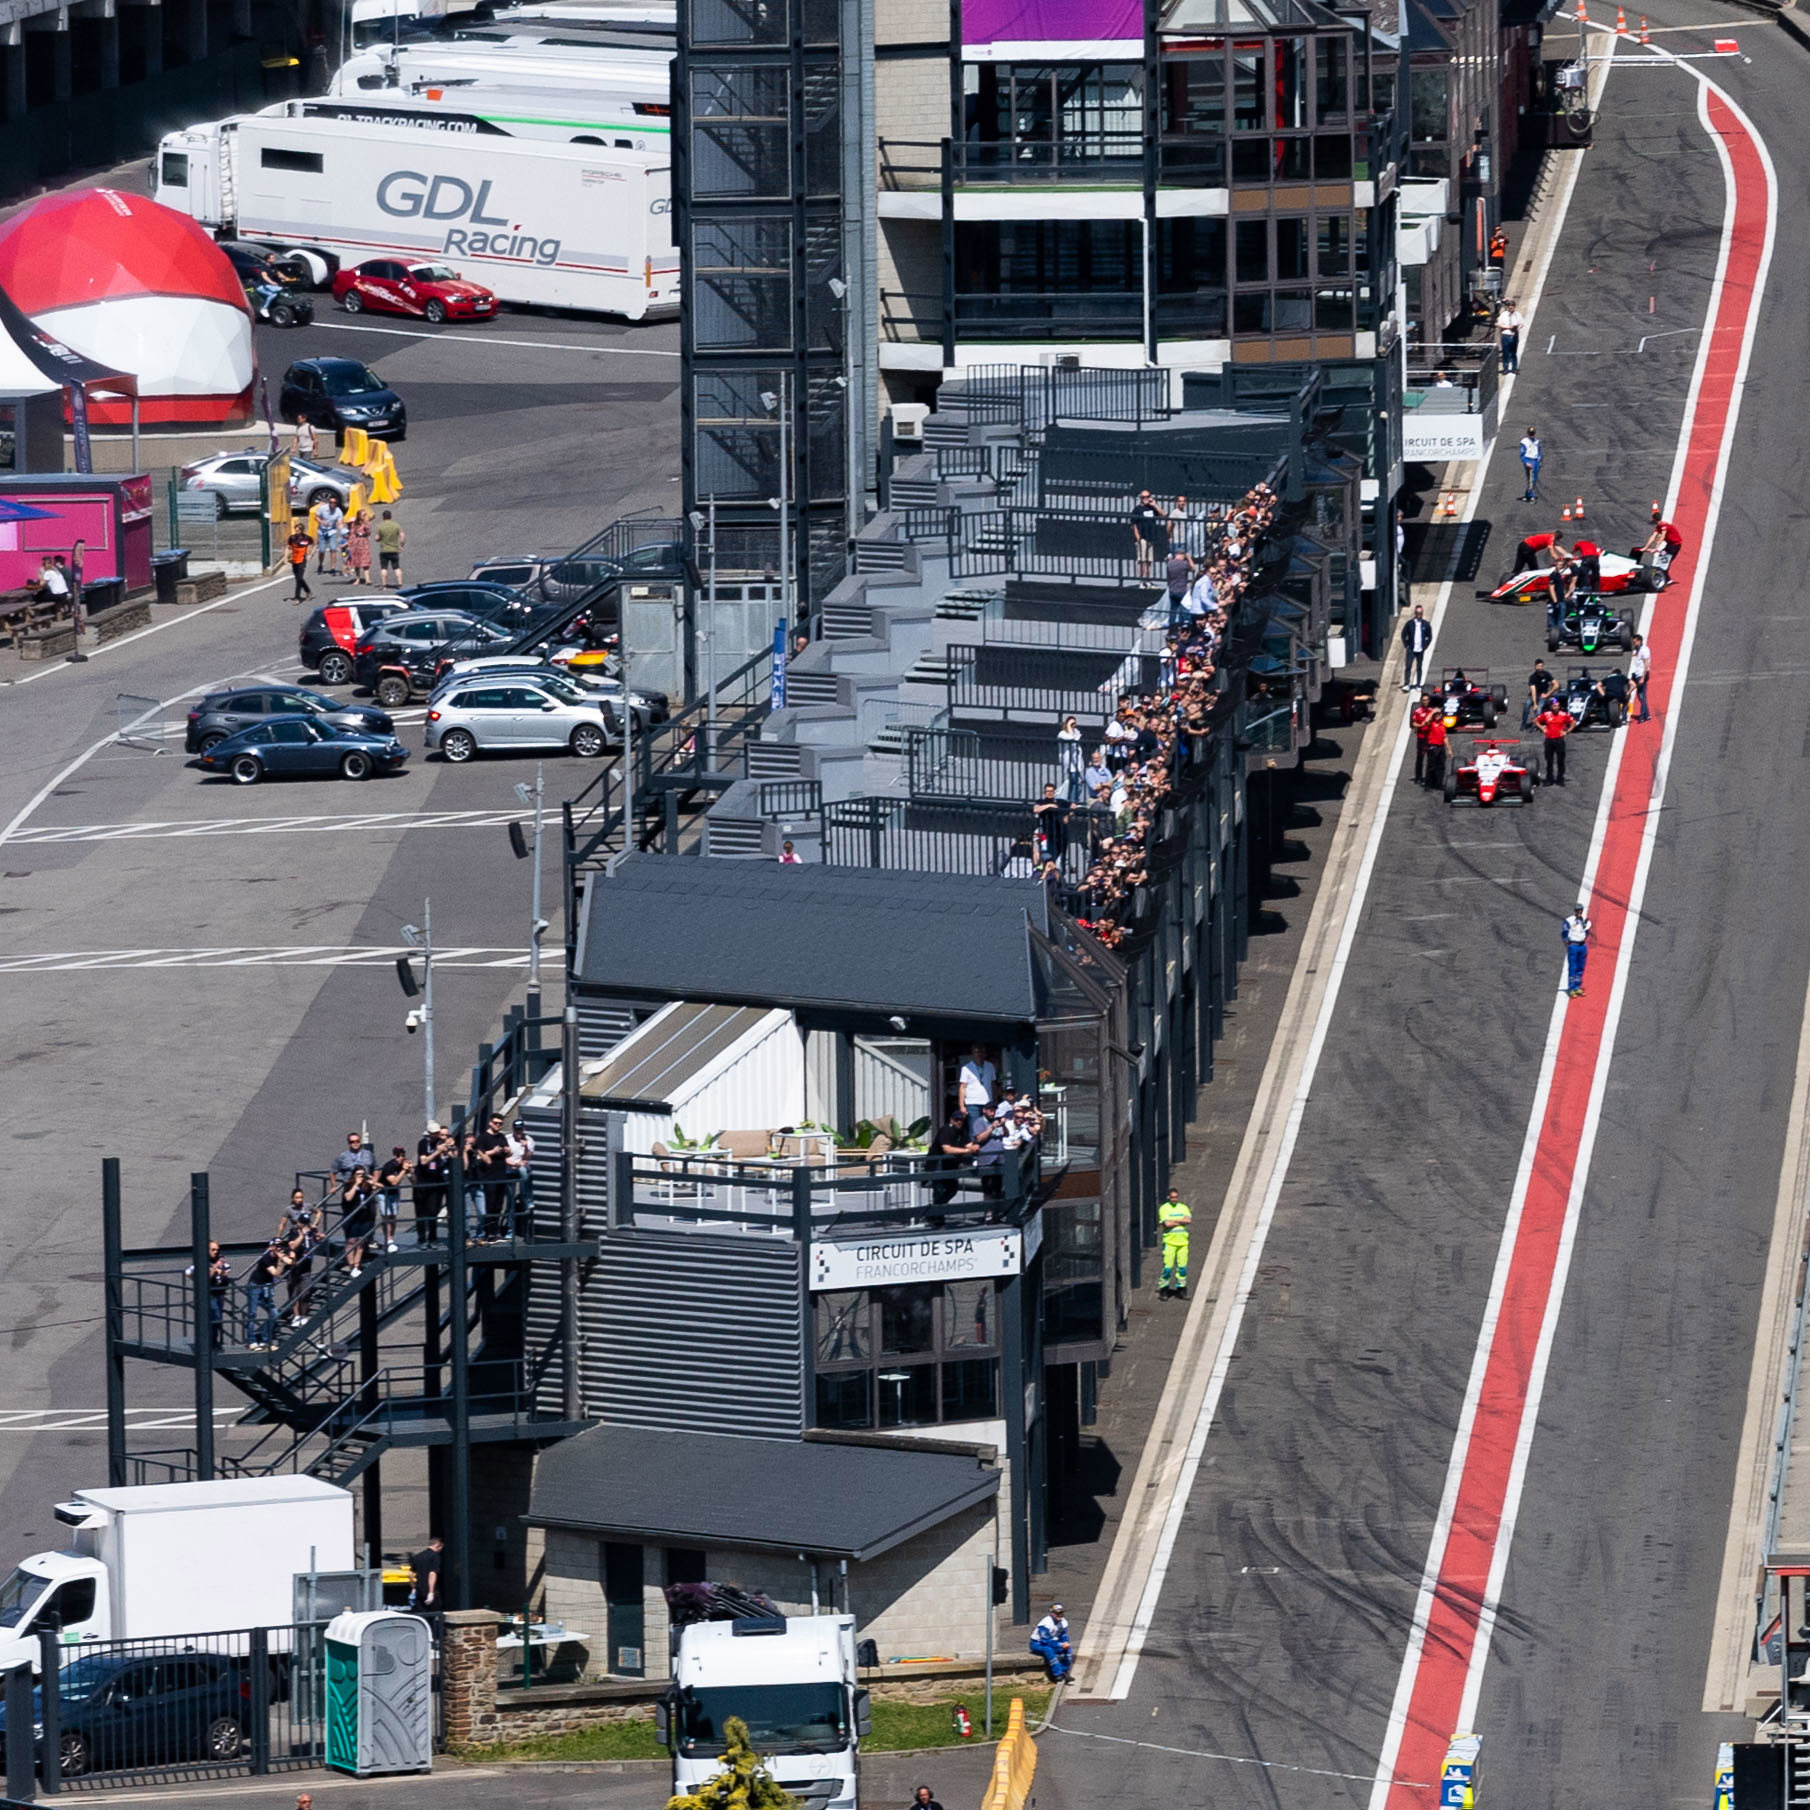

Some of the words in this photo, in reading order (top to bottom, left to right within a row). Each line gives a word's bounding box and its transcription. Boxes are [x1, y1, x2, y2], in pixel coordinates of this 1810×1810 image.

[377, 170, 509, 227] GDL
[444, 224, 561, 266] Racing
[1405, 437, 1437, 447] IRCUIT
[1440, 437, 1452, 446] DE
[1456, 437, 1476, 446] SPA
[1405, 448, 1477, 457] RANCORCHAMPS
[857, 1244, 918, 1261] CIRCUIT
[920, 1242, 942, 1256] DE
[944, 1239, 974, 1255] SPA
[856, 1259, 975, 1279] FRANCORCHAMPS
